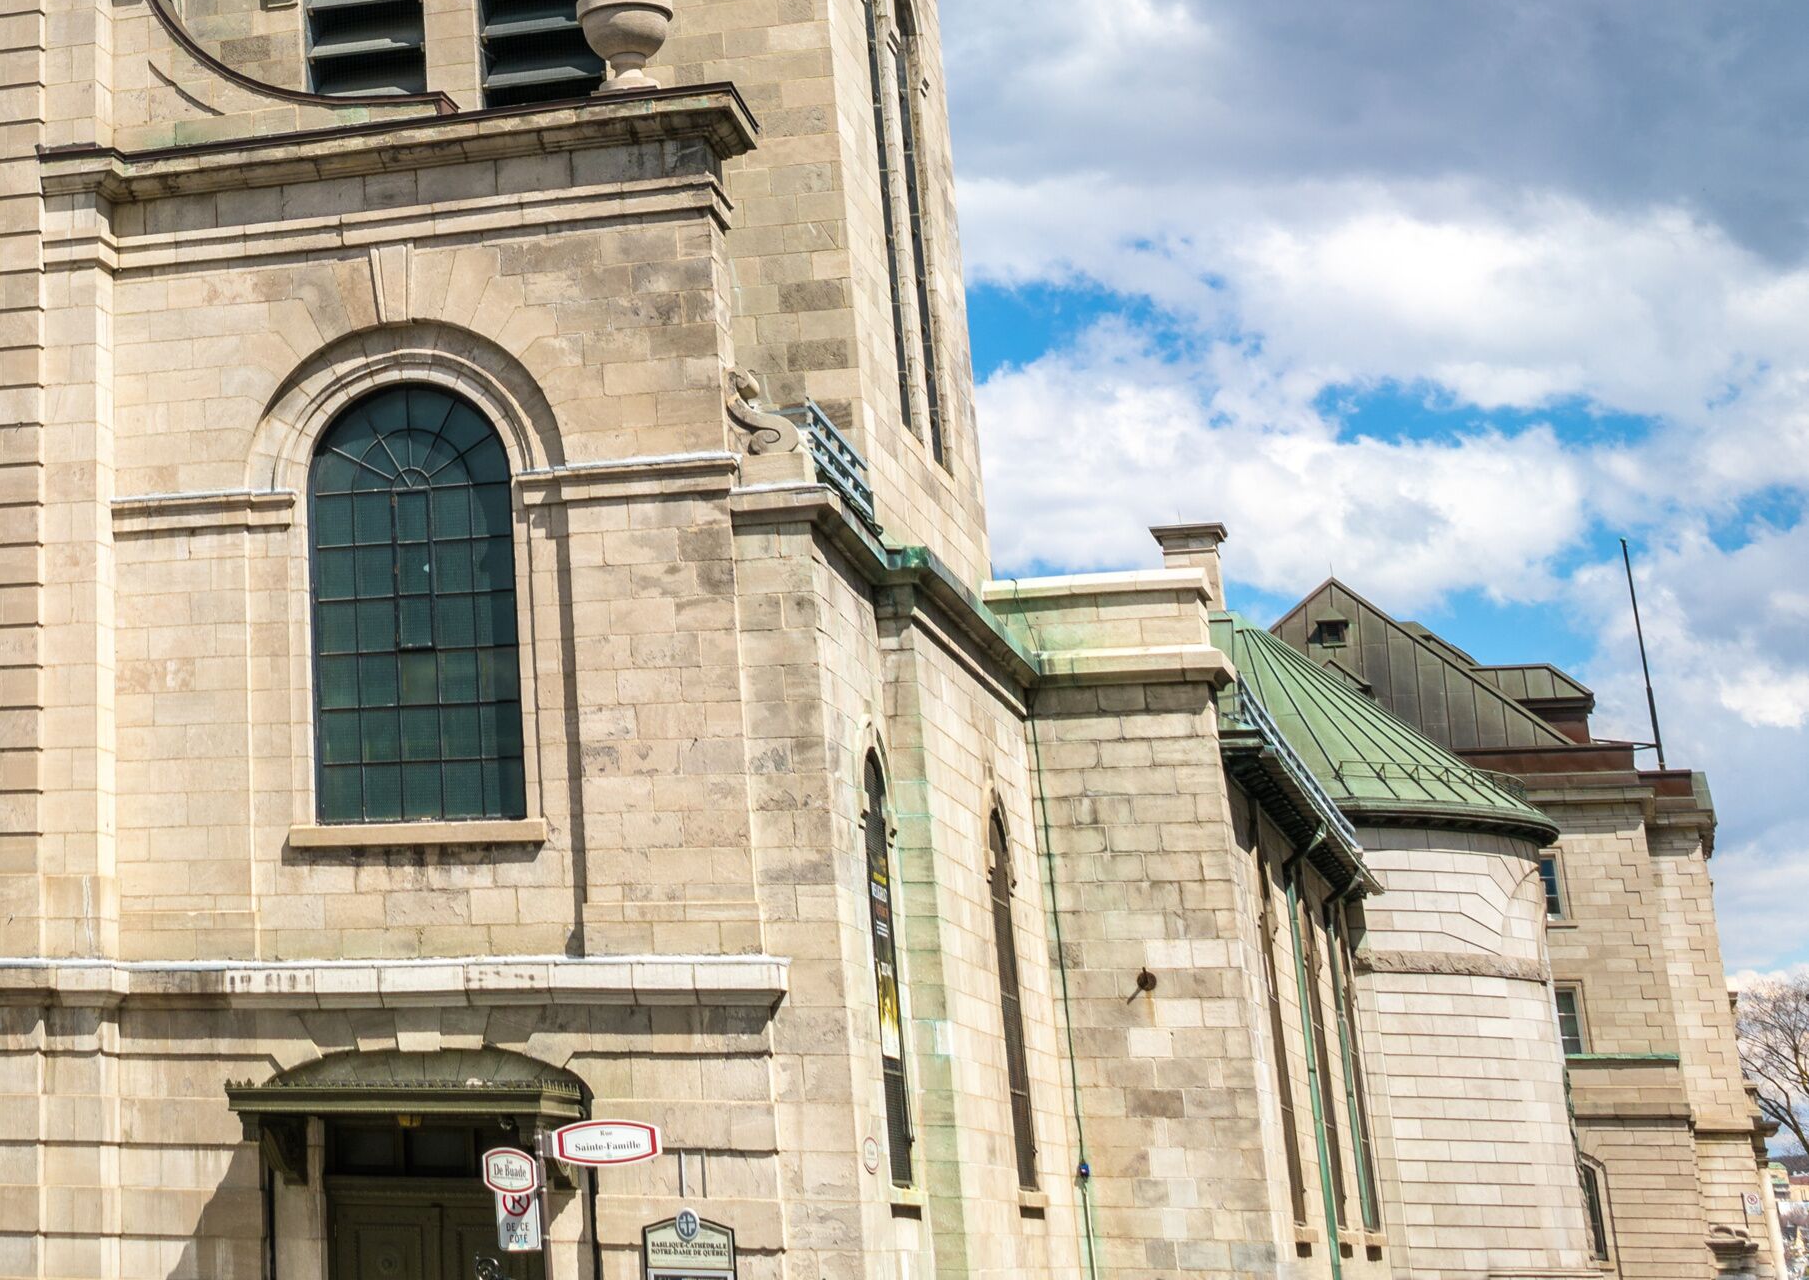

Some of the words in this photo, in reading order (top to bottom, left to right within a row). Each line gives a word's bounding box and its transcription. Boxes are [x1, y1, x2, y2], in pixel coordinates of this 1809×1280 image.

[600, 1129, 613, 1137] Rue
[575, 1140, 641, 1152] Sainte-Famille
[493, 1163, 504, 1176] De
[505, 1164, 527, 1178] Buade
[506, 1222, 517, 1232] DE
[520, 1222, 530, 1232] CE
[651, 1248, 692, 1256] NOTRE-DAME
